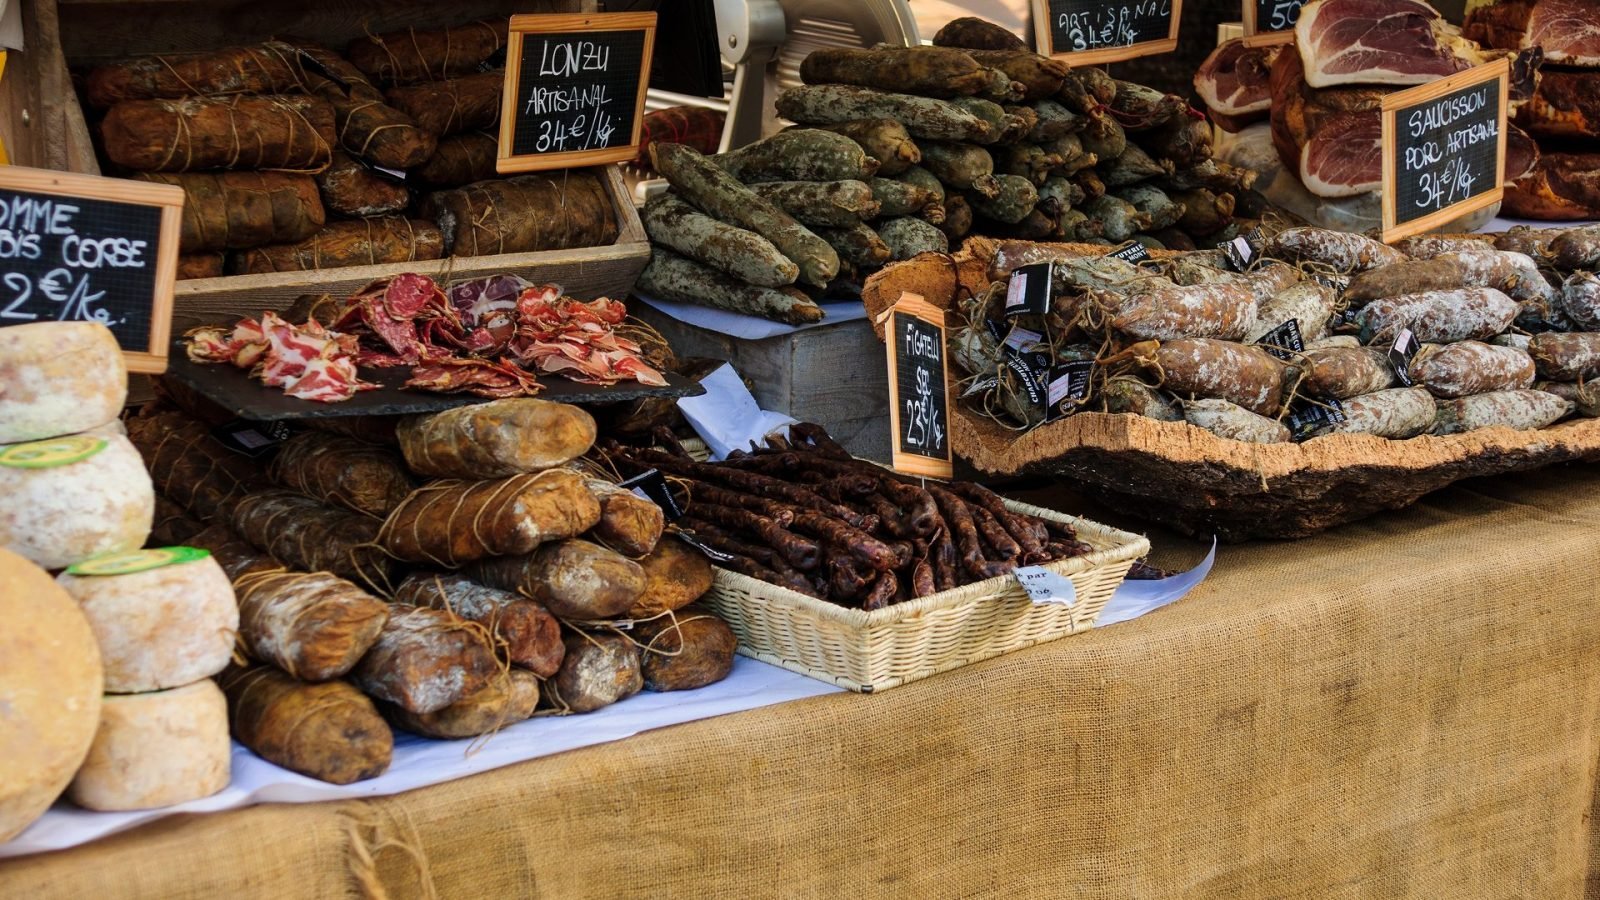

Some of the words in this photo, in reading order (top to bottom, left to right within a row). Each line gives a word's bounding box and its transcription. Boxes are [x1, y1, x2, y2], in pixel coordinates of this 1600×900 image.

[540, 40, 610, 77] LONZU
[1408, 88, 1487, 138] SAUCISSON
[1405, 141, 1443, 170] PORC
[62, 234, 147, 267] CORSE
[916, 365, 932, 396] SEC
